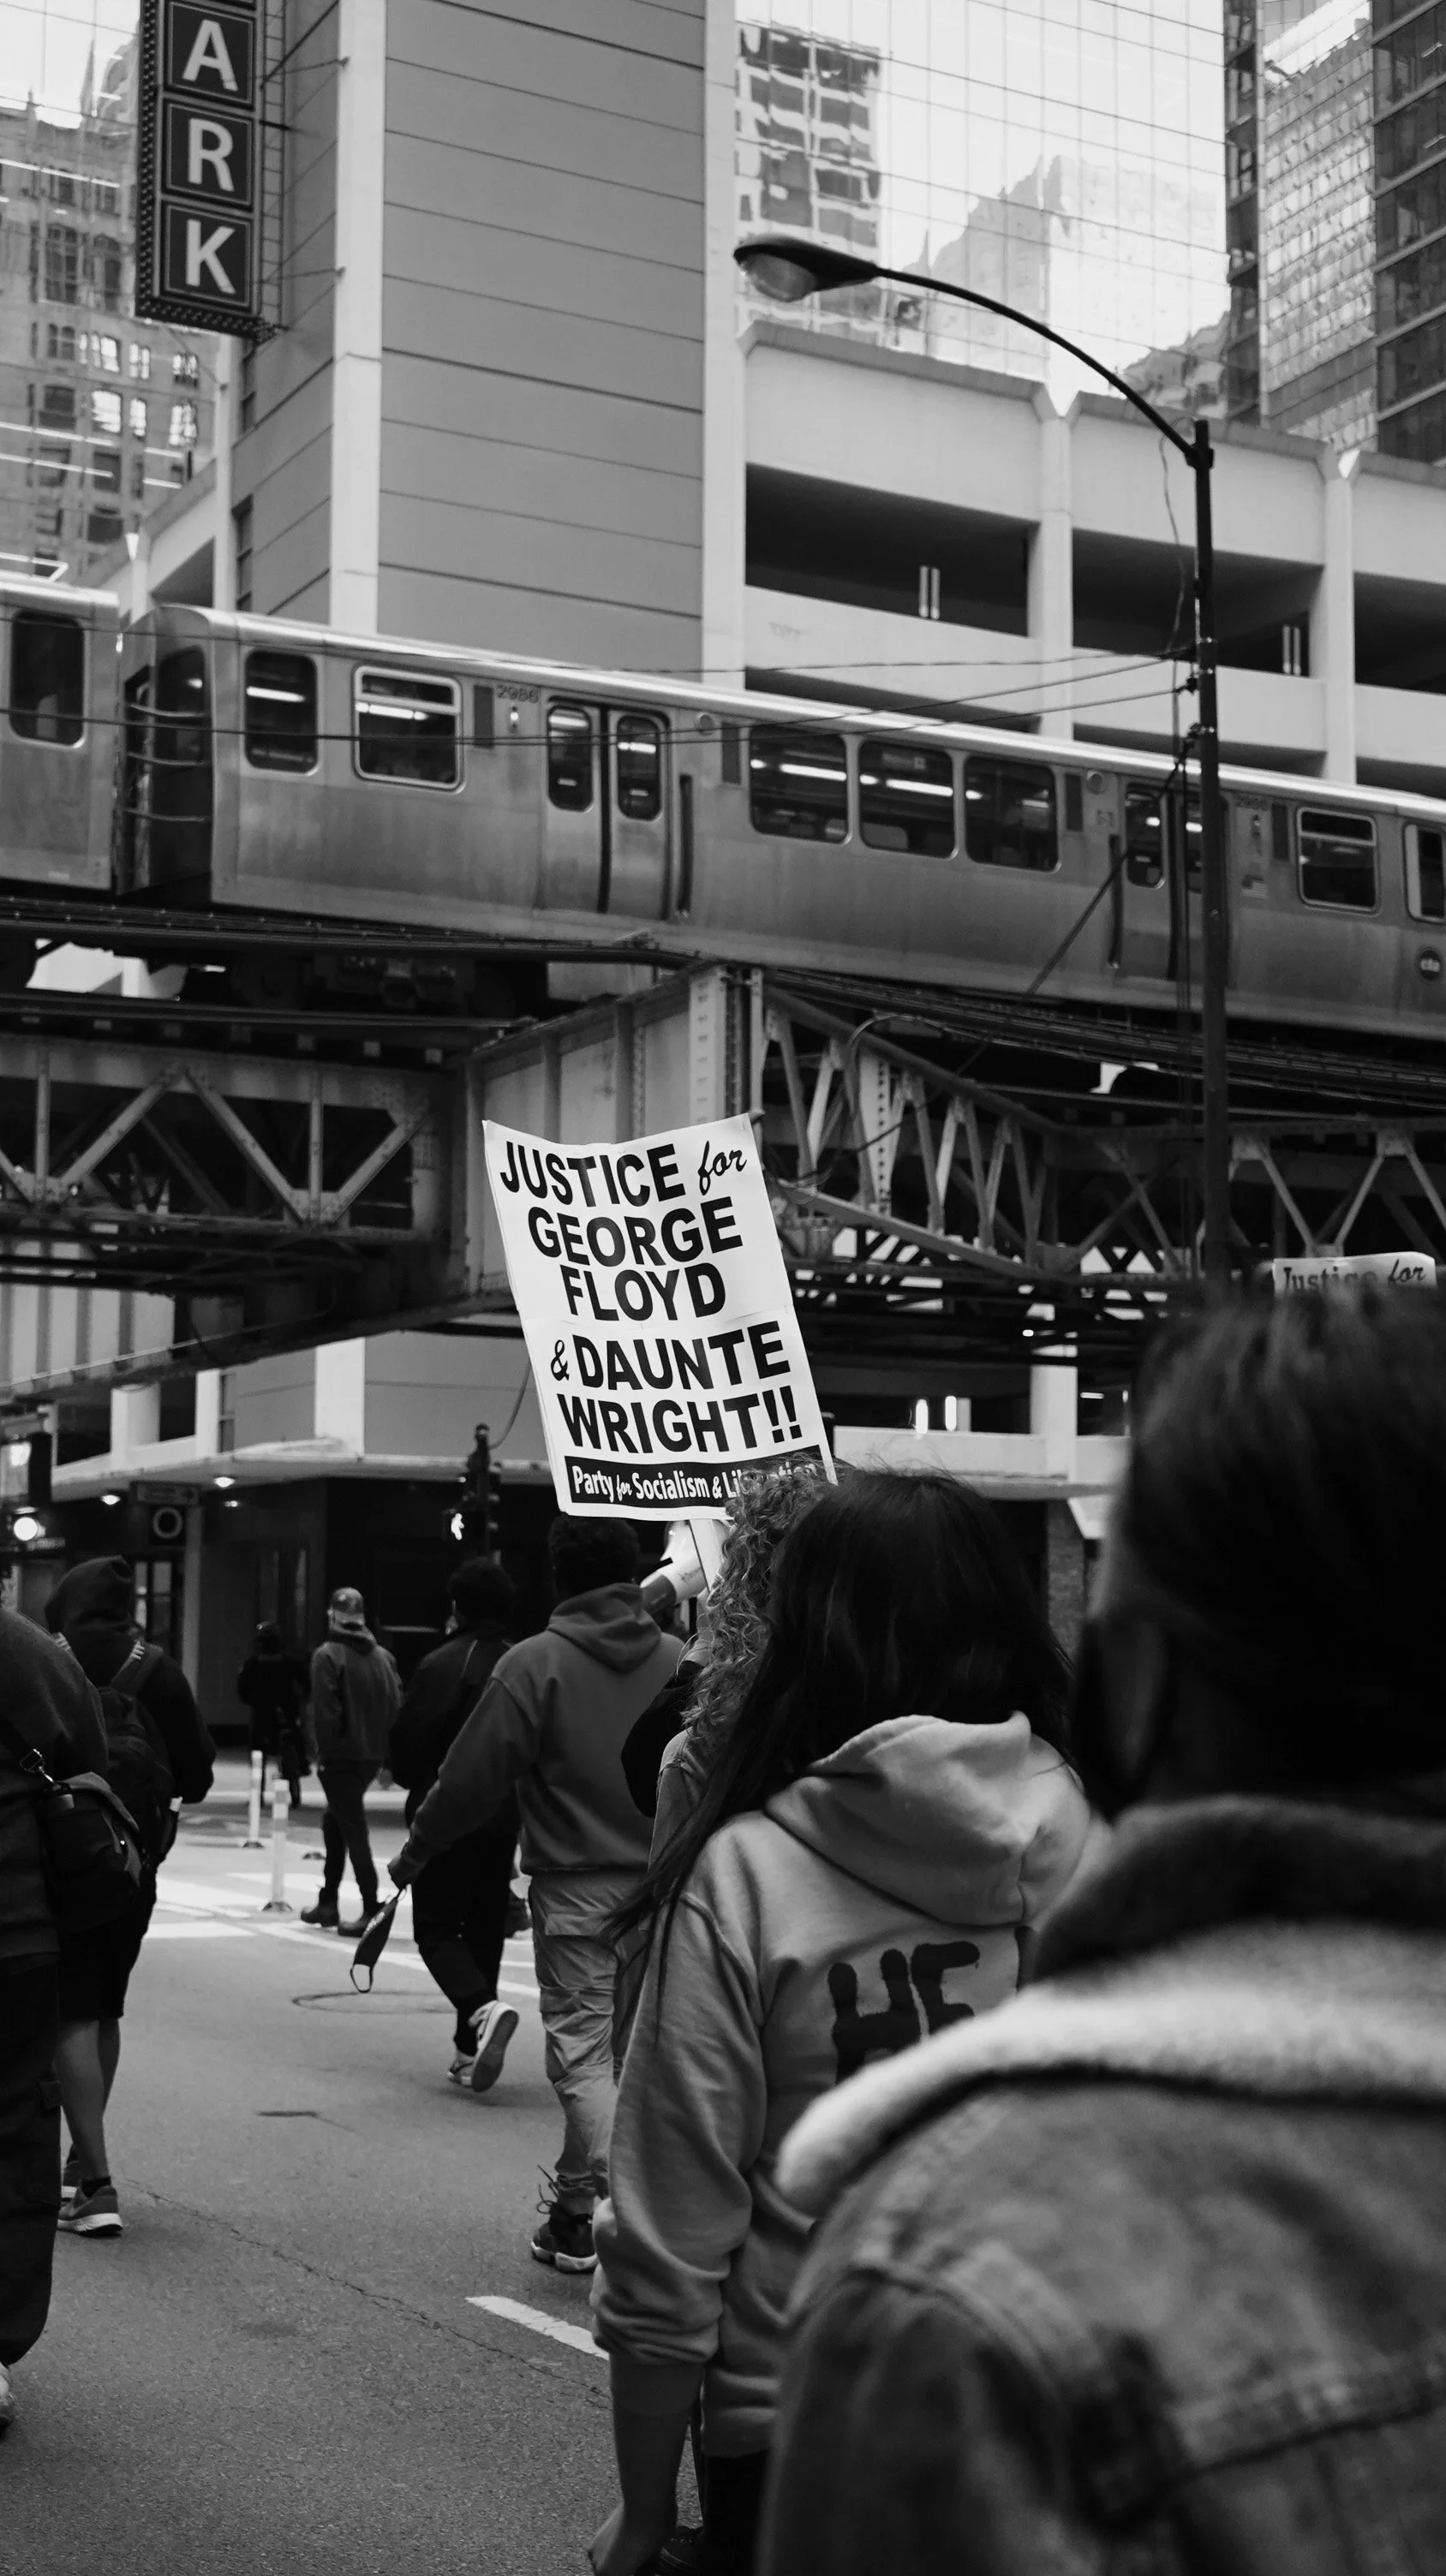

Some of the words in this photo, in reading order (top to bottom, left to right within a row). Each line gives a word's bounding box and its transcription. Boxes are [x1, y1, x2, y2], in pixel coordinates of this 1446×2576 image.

[499, 1141, 686, 1208] JUSTICE
[697, 1140, 748, 1196] for
[528, 1196, 744, 1267] GEORGE
[559, 1262, 726, 1321] FLOYD
[550, 1339, 570, 1381] &
[572, 1320, 792, 1391] DAUNTE
[556, 1385, 803, 1454] WRIGHT!!
[571, 1465, 614, 1503] Party
[615, 1474, 632, 1501] for
[632, 1470, 711, 1500] Socialism
[712, 1476, 722, 1499] &
